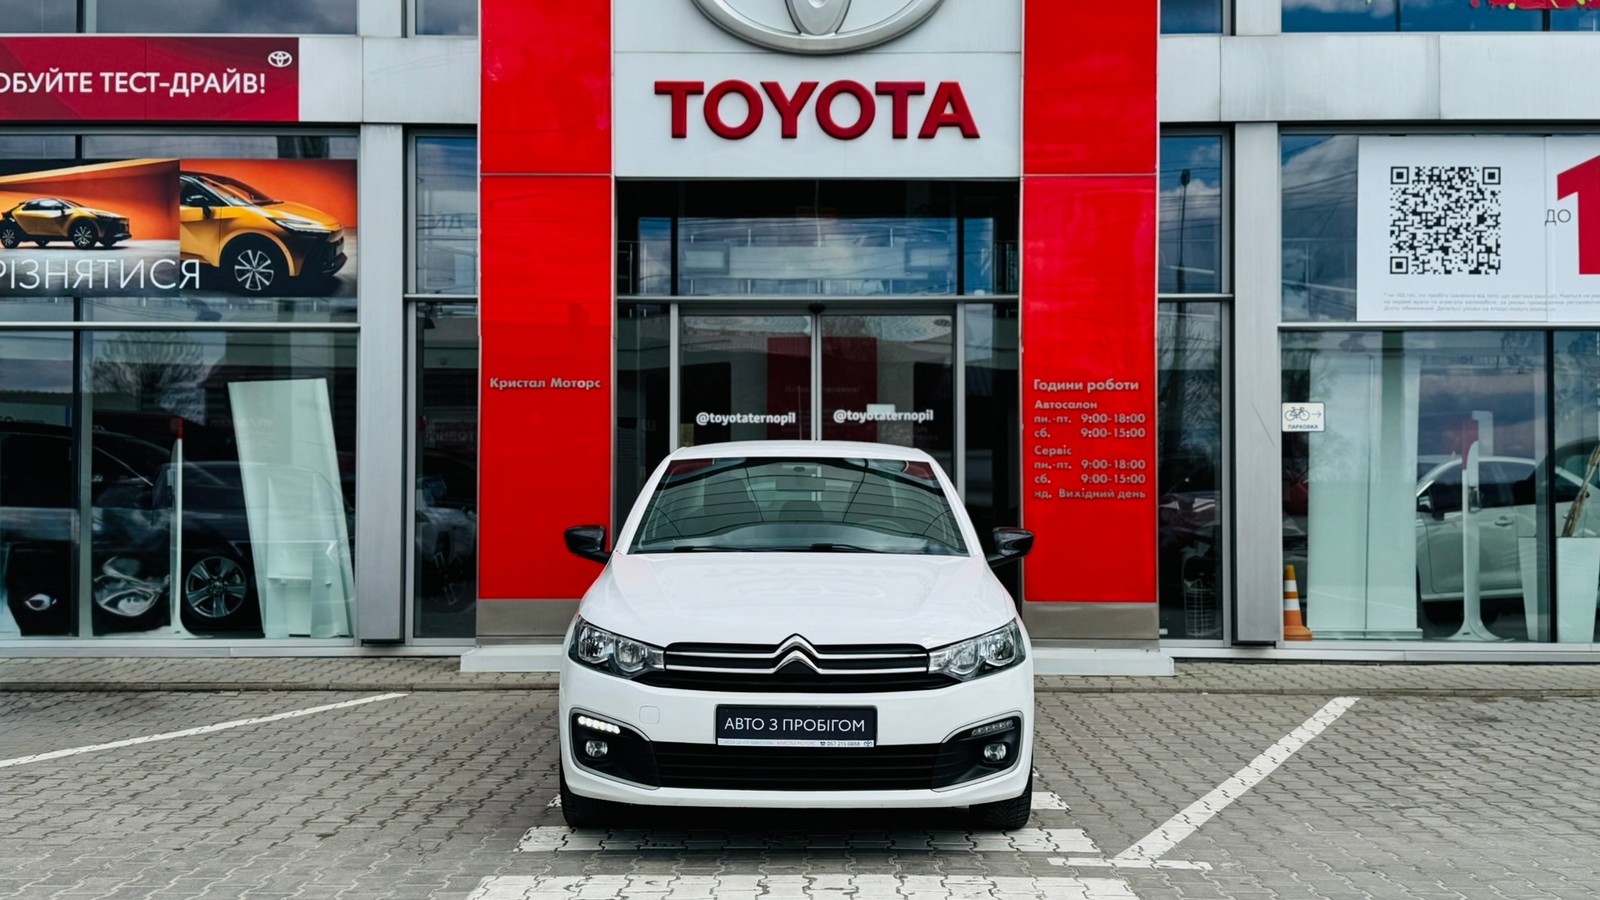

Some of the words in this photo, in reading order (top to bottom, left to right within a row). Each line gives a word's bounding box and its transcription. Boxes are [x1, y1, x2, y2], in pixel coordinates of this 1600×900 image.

[100, 68, 266, 97] ТЕСТ-ДРАЙВ!
[654, 79, 981, 141] TOYOTA
[1545, 208, 1572, 227] ДО
[490, 377, 546, 391] Кристал
[551, 377, 601, 391] Моторс
[1033, 379, 1083, 391] Години
[1087, 378, 1139, 393] роботи
[1034, 400, 1098, 410] Автосалон
[696, 411, 796, 427] @toyotaternopil
[833, 408, 934, 425] @toyotaternopil
[1034, 427, 1051, 438] сб.
[1034, 444, 1073, 457] Сервіс
[1034, 473, 1051, 484] сб.
[1034, 490, 1053, 499] нд.
[1058, 488, 1115, 500] Вихідний
[1118, 490, 1146, 500] день
[724, 717, 765, 730] АВТО
[769, 718, 778, 731] З
[782, 718, 865, 732] ПРОБІГОМ
